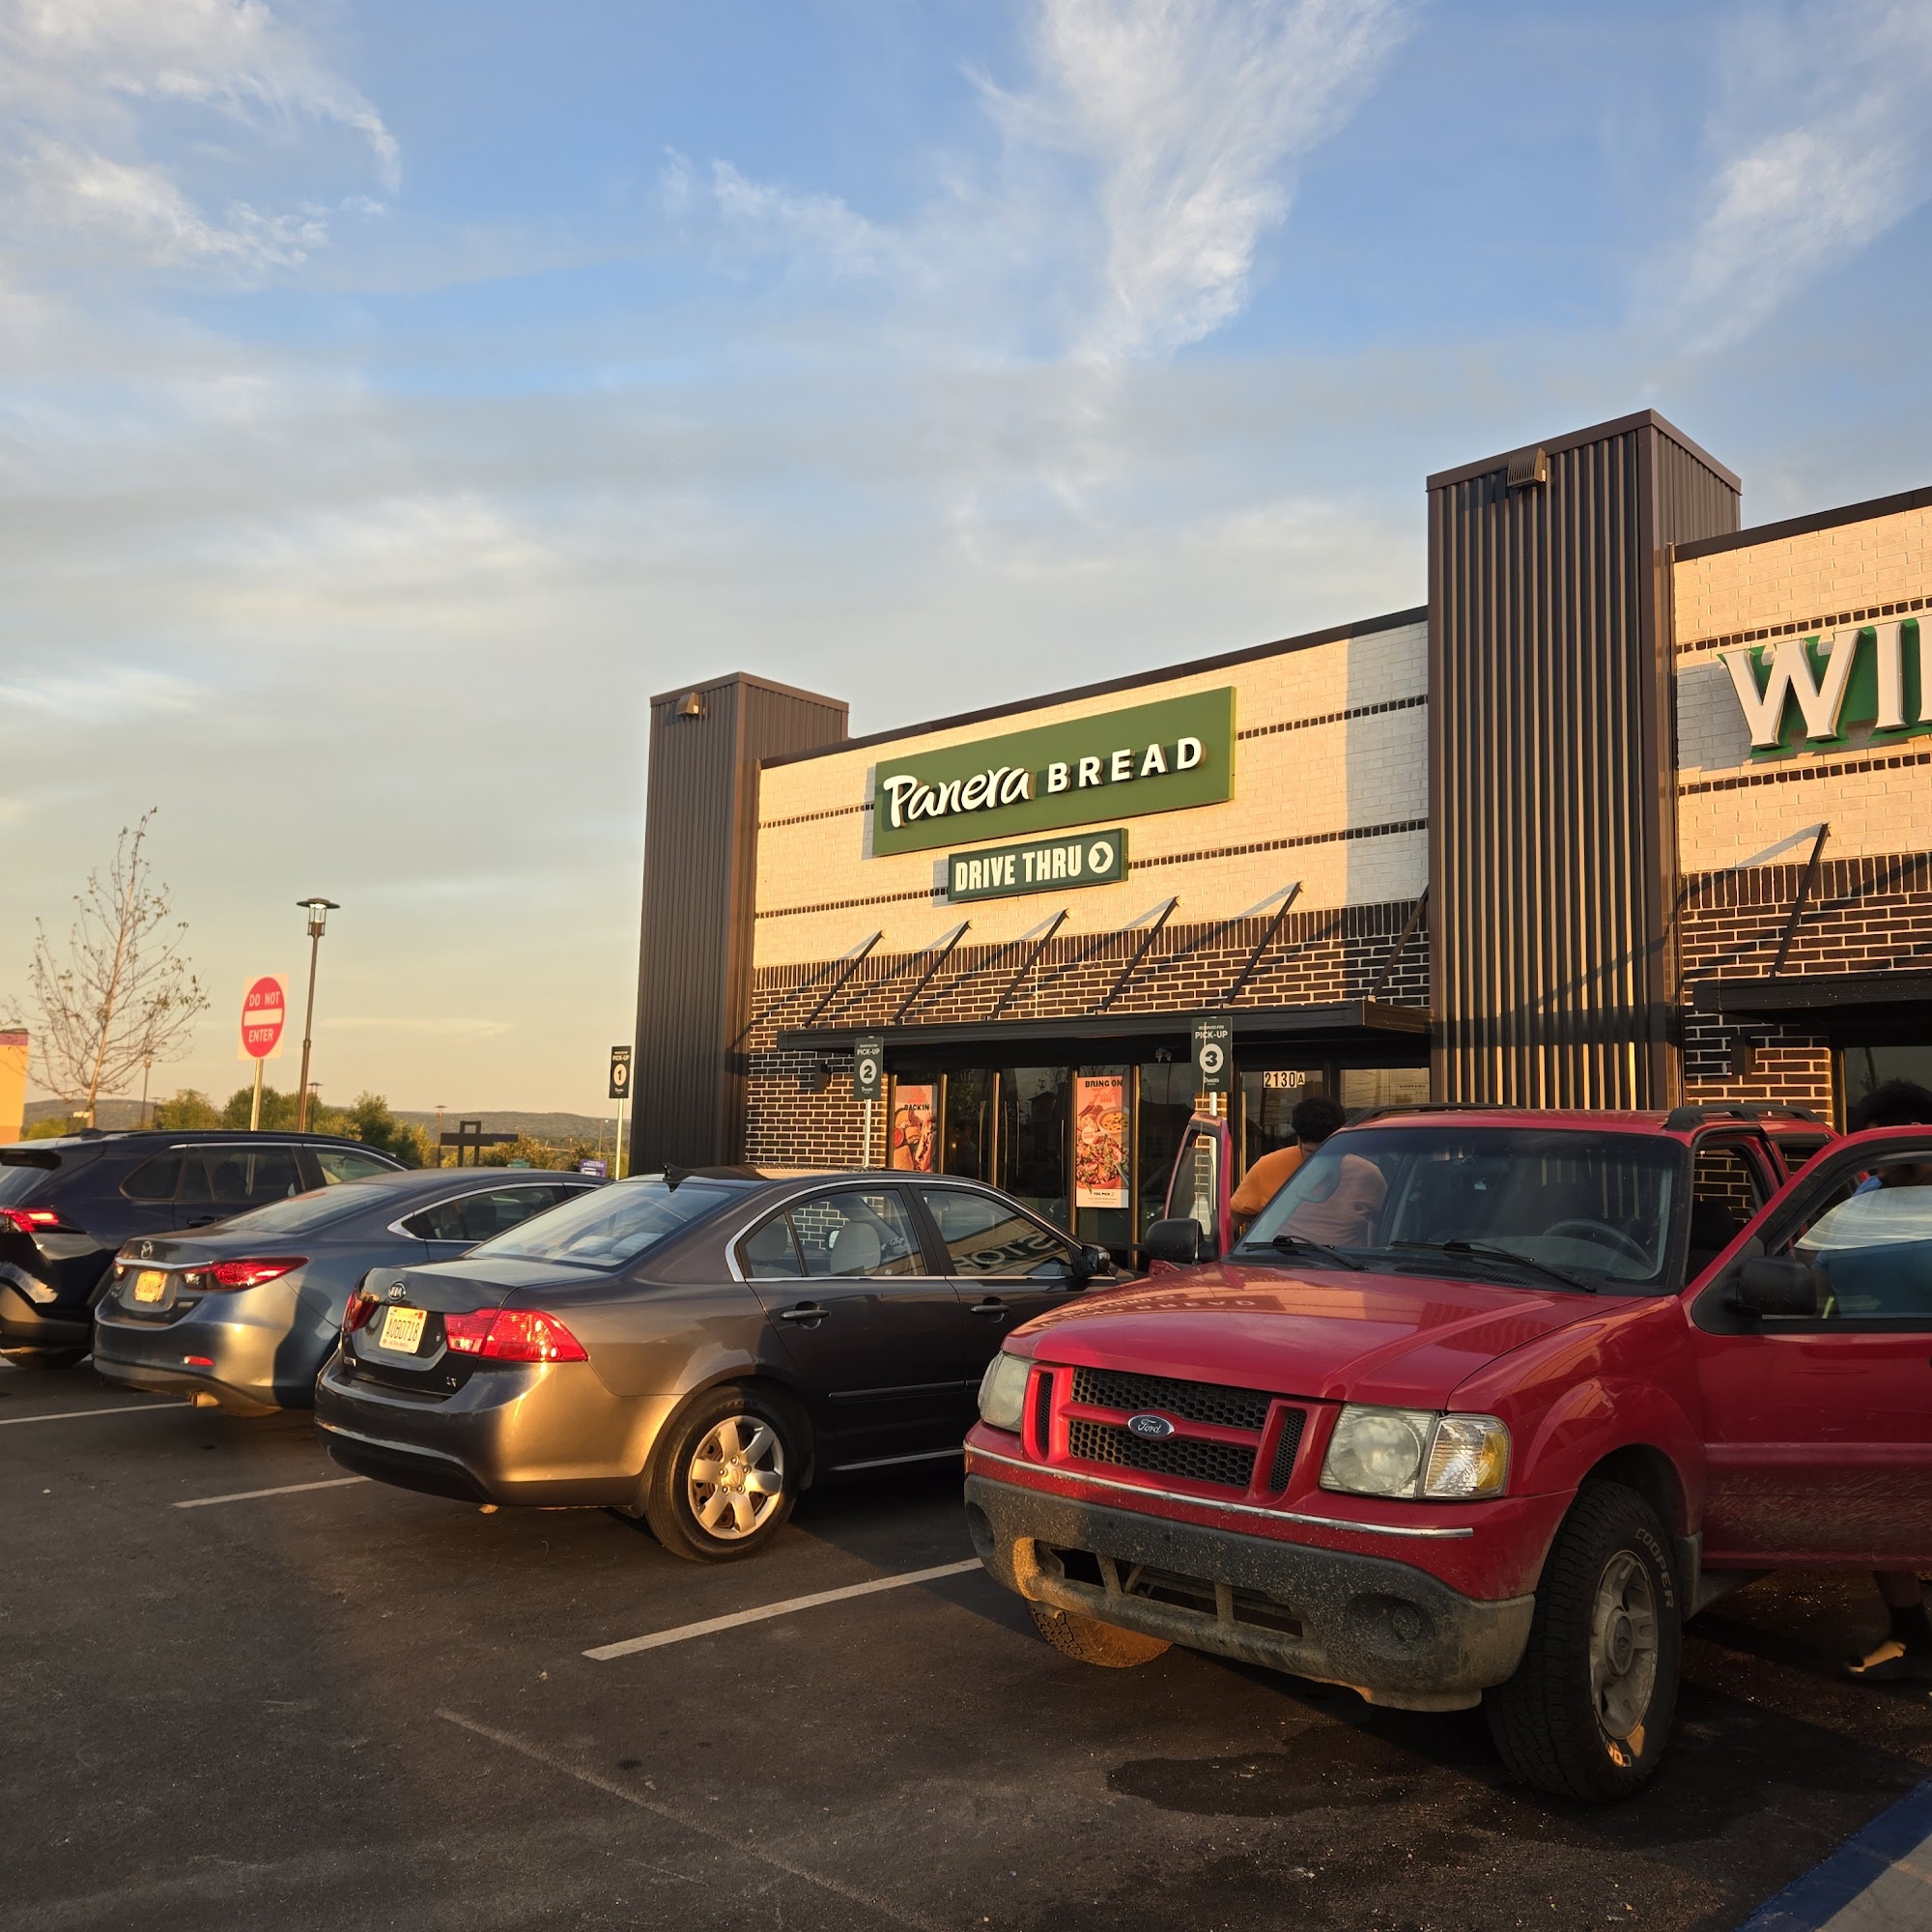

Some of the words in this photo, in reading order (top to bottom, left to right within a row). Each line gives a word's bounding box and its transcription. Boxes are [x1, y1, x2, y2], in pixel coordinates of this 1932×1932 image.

[1721, 616, 1932, 747] WI
[883, 766, 1032, 828] Panera
[1047, 737, 1205, 793] BREAD
[954, 856, 1015, 892] DRIVE
[1022, 844, 1082, 882] THRU
[249, 993, 261, 1008] DO
[264, 991, 280, 1007] NOT
[248, 1028, 273, 1043] ENTER
[1195, 1031, 1228, 1039] PICK-UP
[1205, 1050, 1218, 1067] 3
[617, 1069, 622, 1080] 1
[863, 1065, 872, 1078] 2
[1137, 1418, 1162, 1434] Ford
[1634, 1528, 1674, 1608] COOPER
